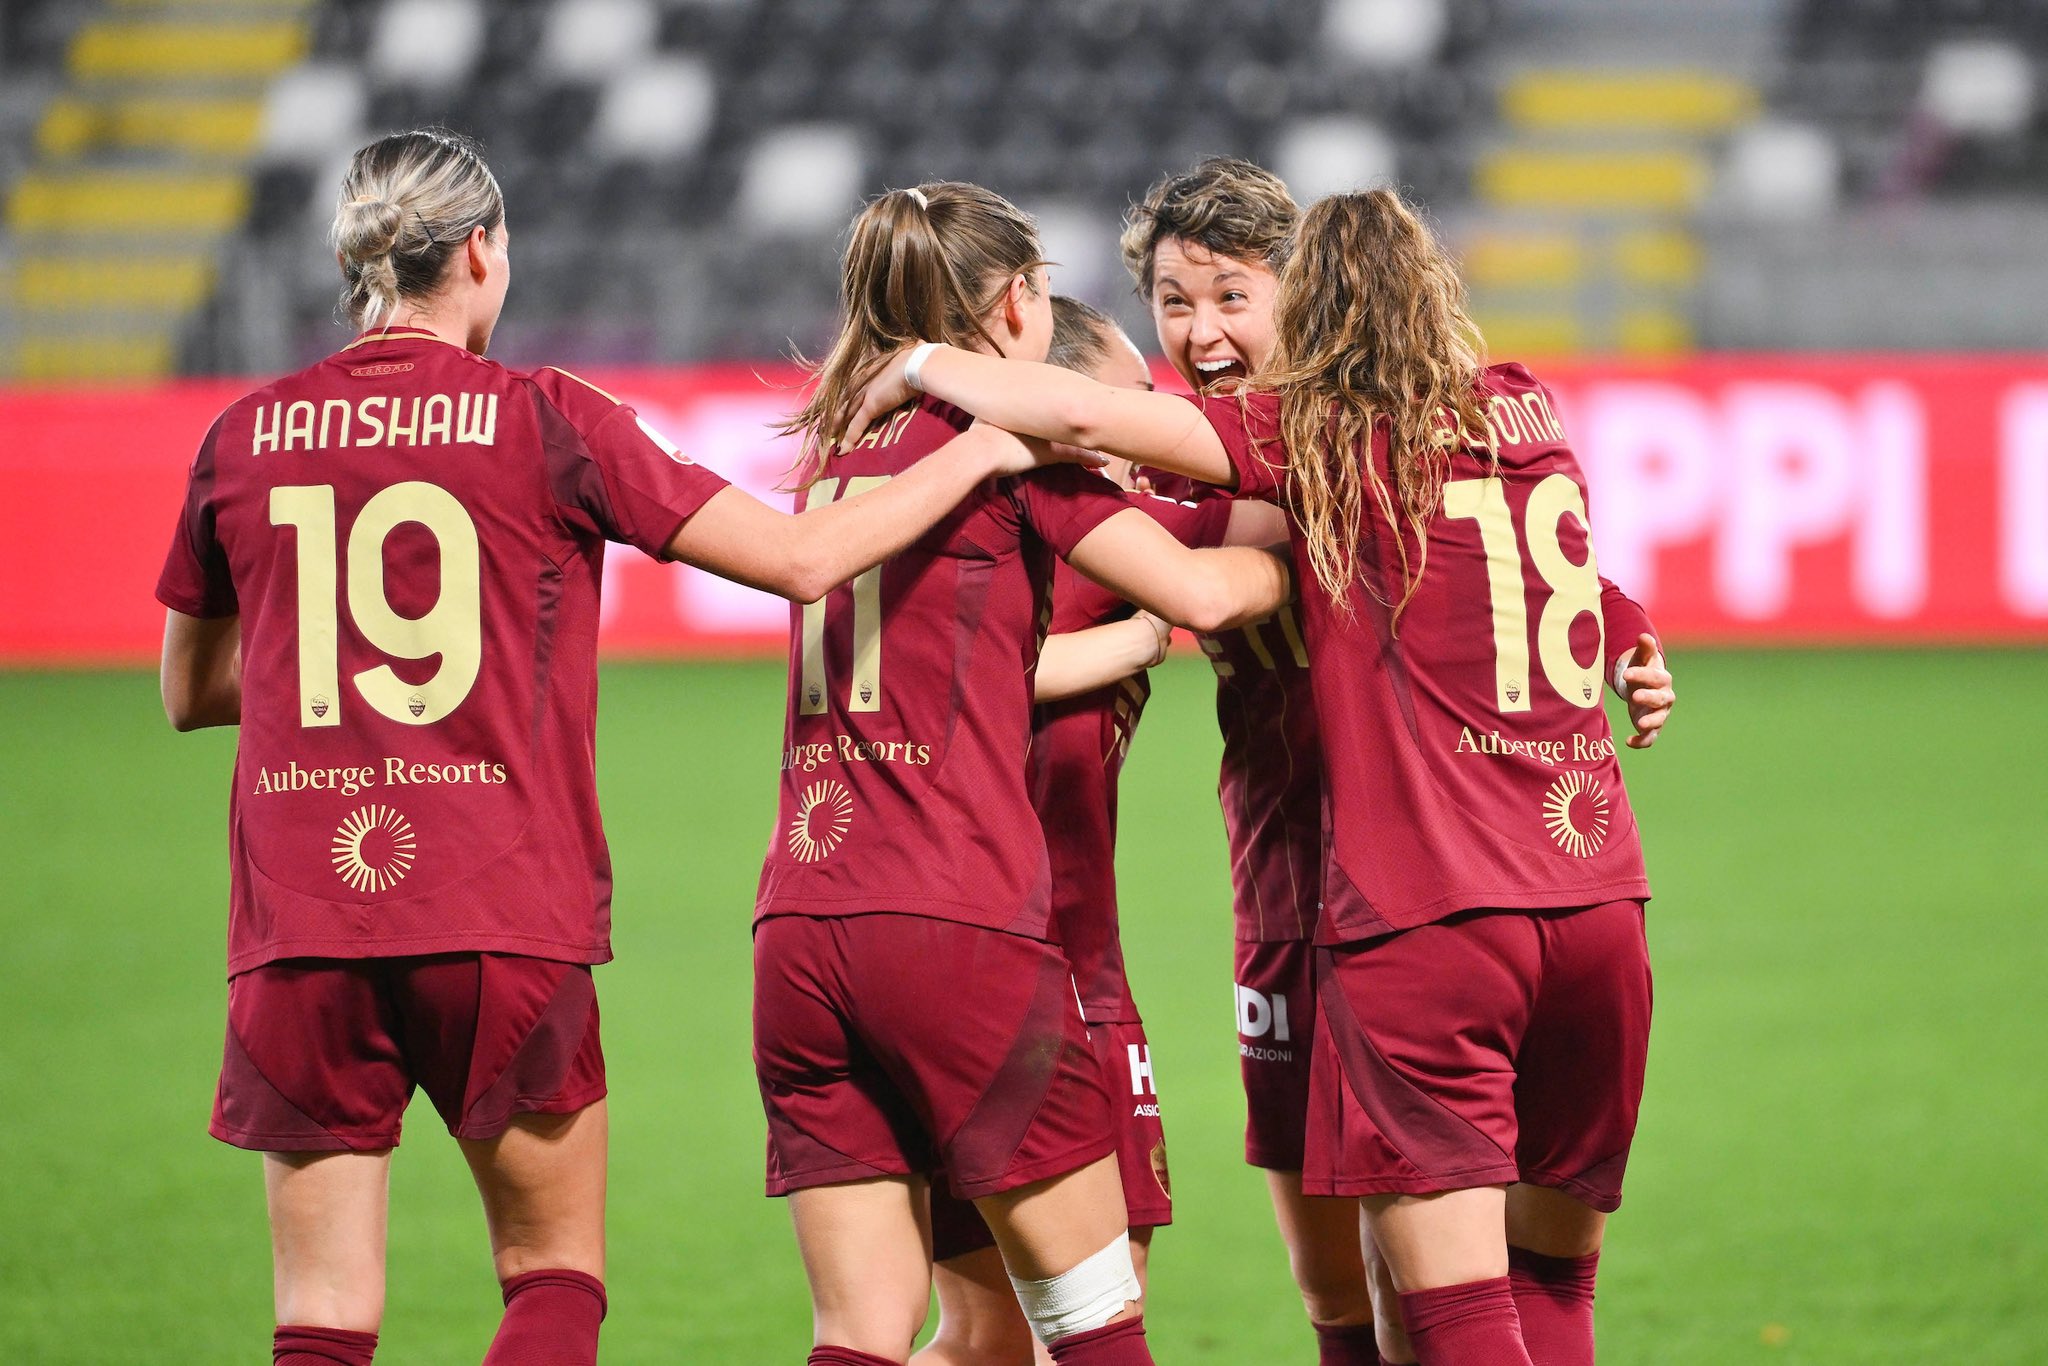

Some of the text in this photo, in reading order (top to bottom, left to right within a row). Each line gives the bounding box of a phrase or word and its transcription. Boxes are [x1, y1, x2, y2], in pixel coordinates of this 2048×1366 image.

[252, 391, 499, 456] HANSHAW
[1588, 382, 1926, 618] PPI
[269, 481, 482, 729] 19
[1444, 473, 1605, 713] 18
[253, 756, 507, 797] Auberge Resorts
[1454, 726, 1616, 767] Auberge Reso
[1239, 1043, 1292, 1061] RAZIONI
